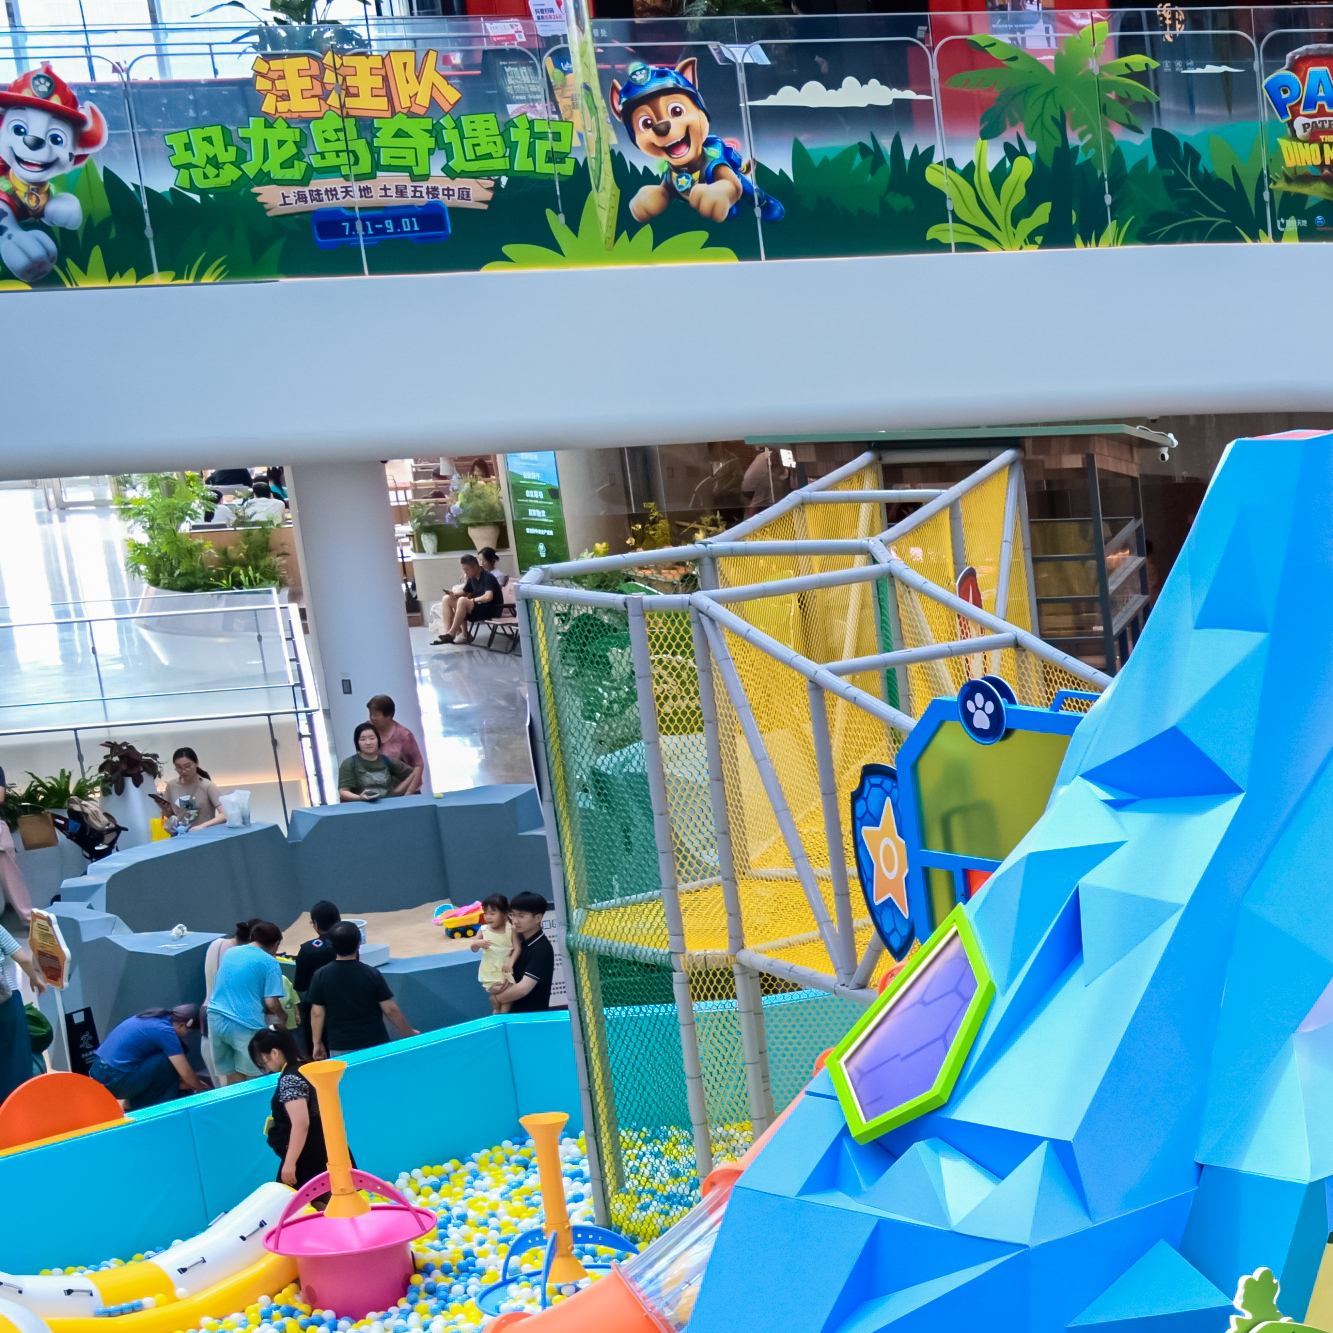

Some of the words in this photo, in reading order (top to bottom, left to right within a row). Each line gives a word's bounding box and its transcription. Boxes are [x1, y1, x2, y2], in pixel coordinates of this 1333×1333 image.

[251, 48, 463, 119] 汪汪队
[165, 112, 579, 191] 恐龙岛奇遇记
[1279, 139, 1321, 168] DINO
[278, 183, 375, 207] 上海陆悦天地
[376, 183, 473, 203] 土星五楼中庭
[341, 217, 421, 236] 7.1-9.01
